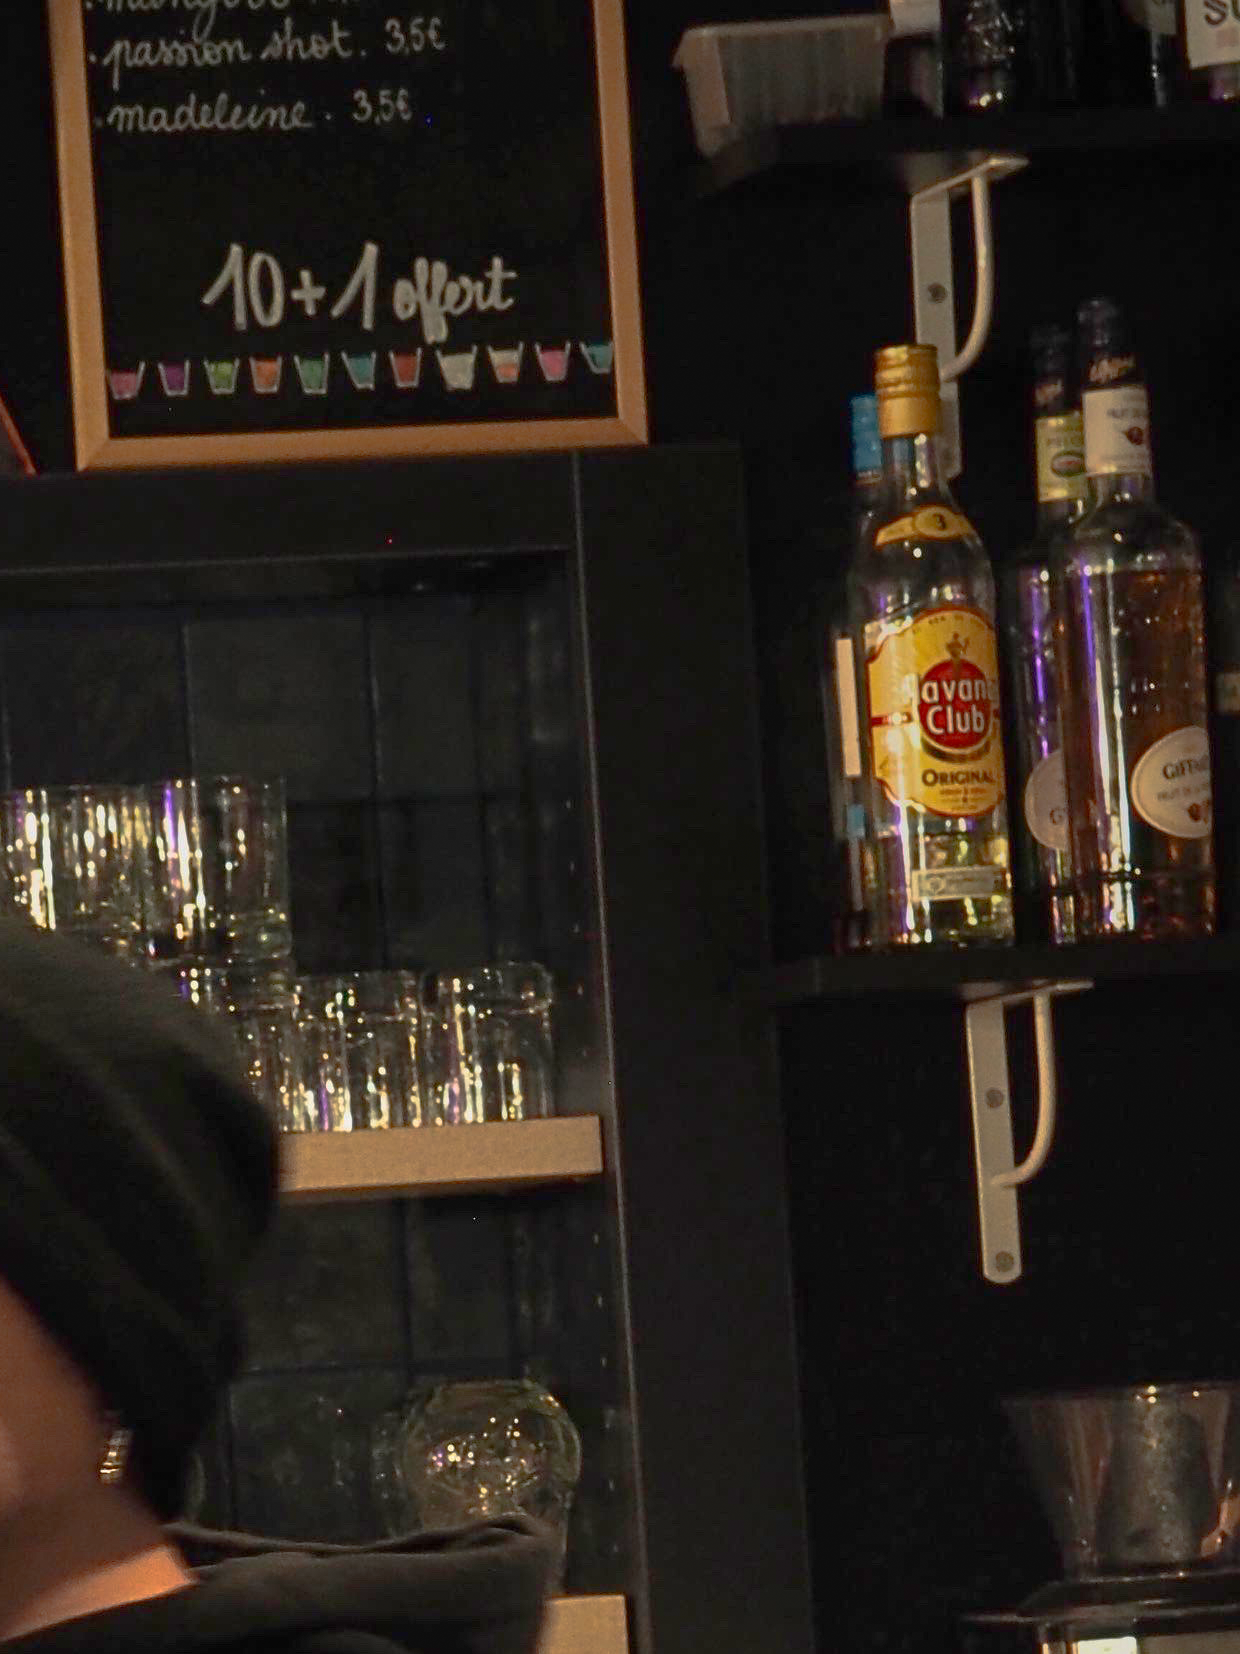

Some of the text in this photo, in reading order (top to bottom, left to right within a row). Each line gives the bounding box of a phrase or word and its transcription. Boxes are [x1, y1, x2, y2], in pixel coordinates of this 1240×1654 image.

[103, 28, 252, 91] passion
[260, 16, 352, 61] shot
[107, 89, 313, 132] madeleine
[392, 255, 518, 344] offert
[926, 704, 986, 735] Club
